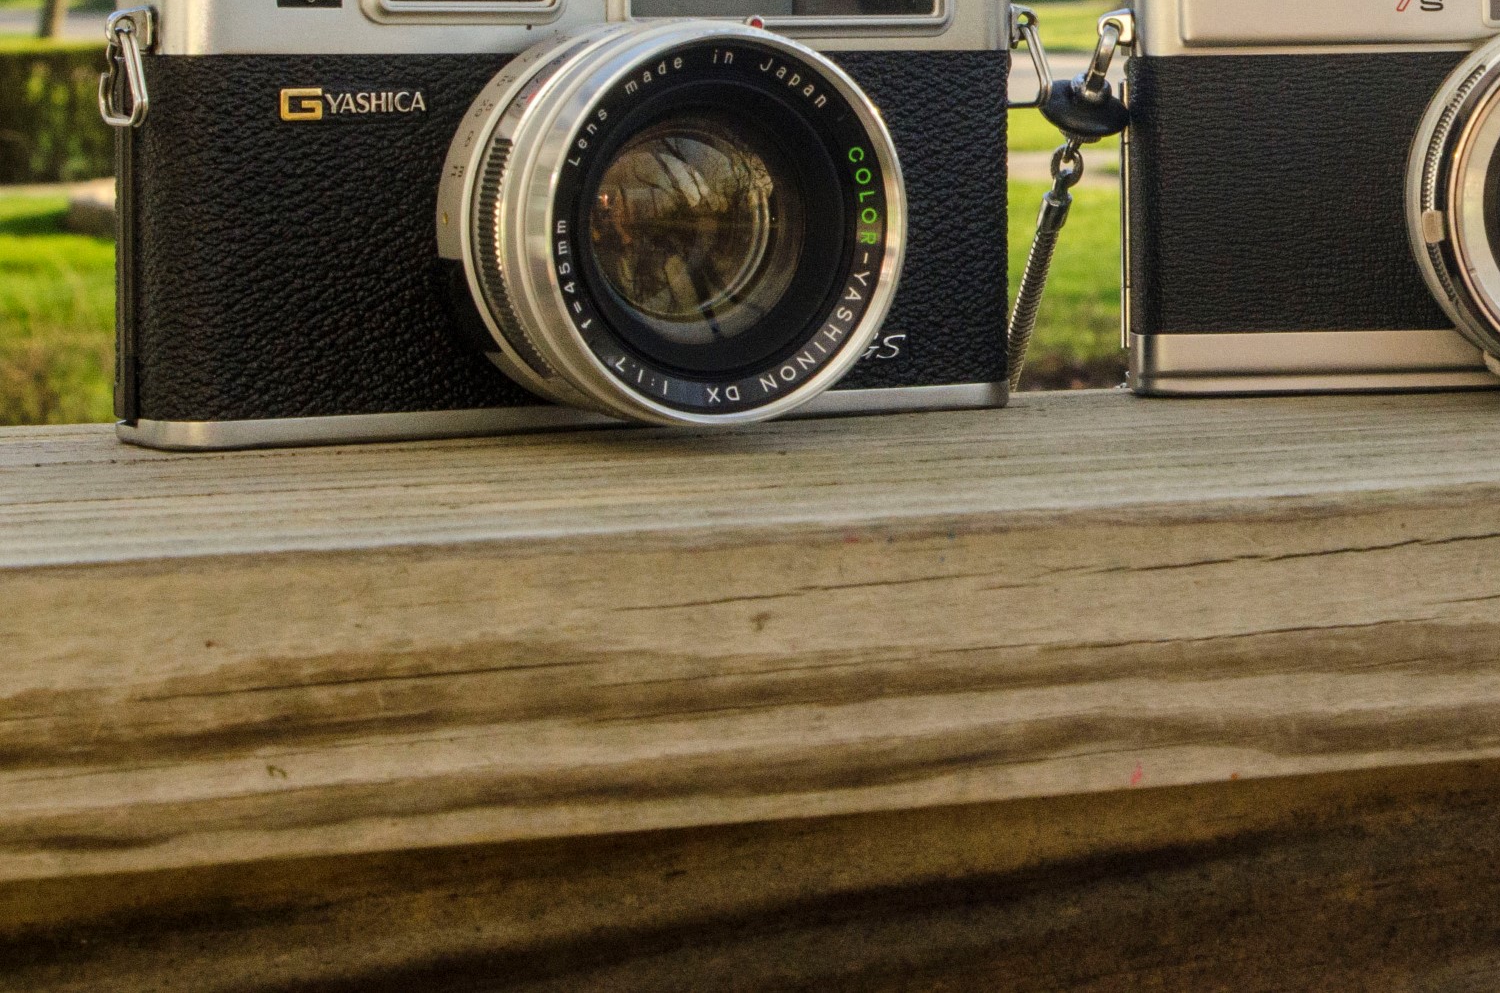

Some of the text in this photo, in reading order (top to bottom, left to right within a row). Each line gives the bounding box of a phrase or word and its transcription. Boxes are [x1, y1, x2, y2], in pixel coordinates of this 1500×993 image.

[324, 91, 426, 115] YASHICA
[568, 107, 607, 167] Lens
[625, 56, 684, 94] made
[712, 49, 734, 64] in
[759, 57, 828, 108] Japan
[556, 220, 592, 330] f=45mm
[615, 355, 668, 395] 1:1.7
[708, 385, 741, 403] DX
